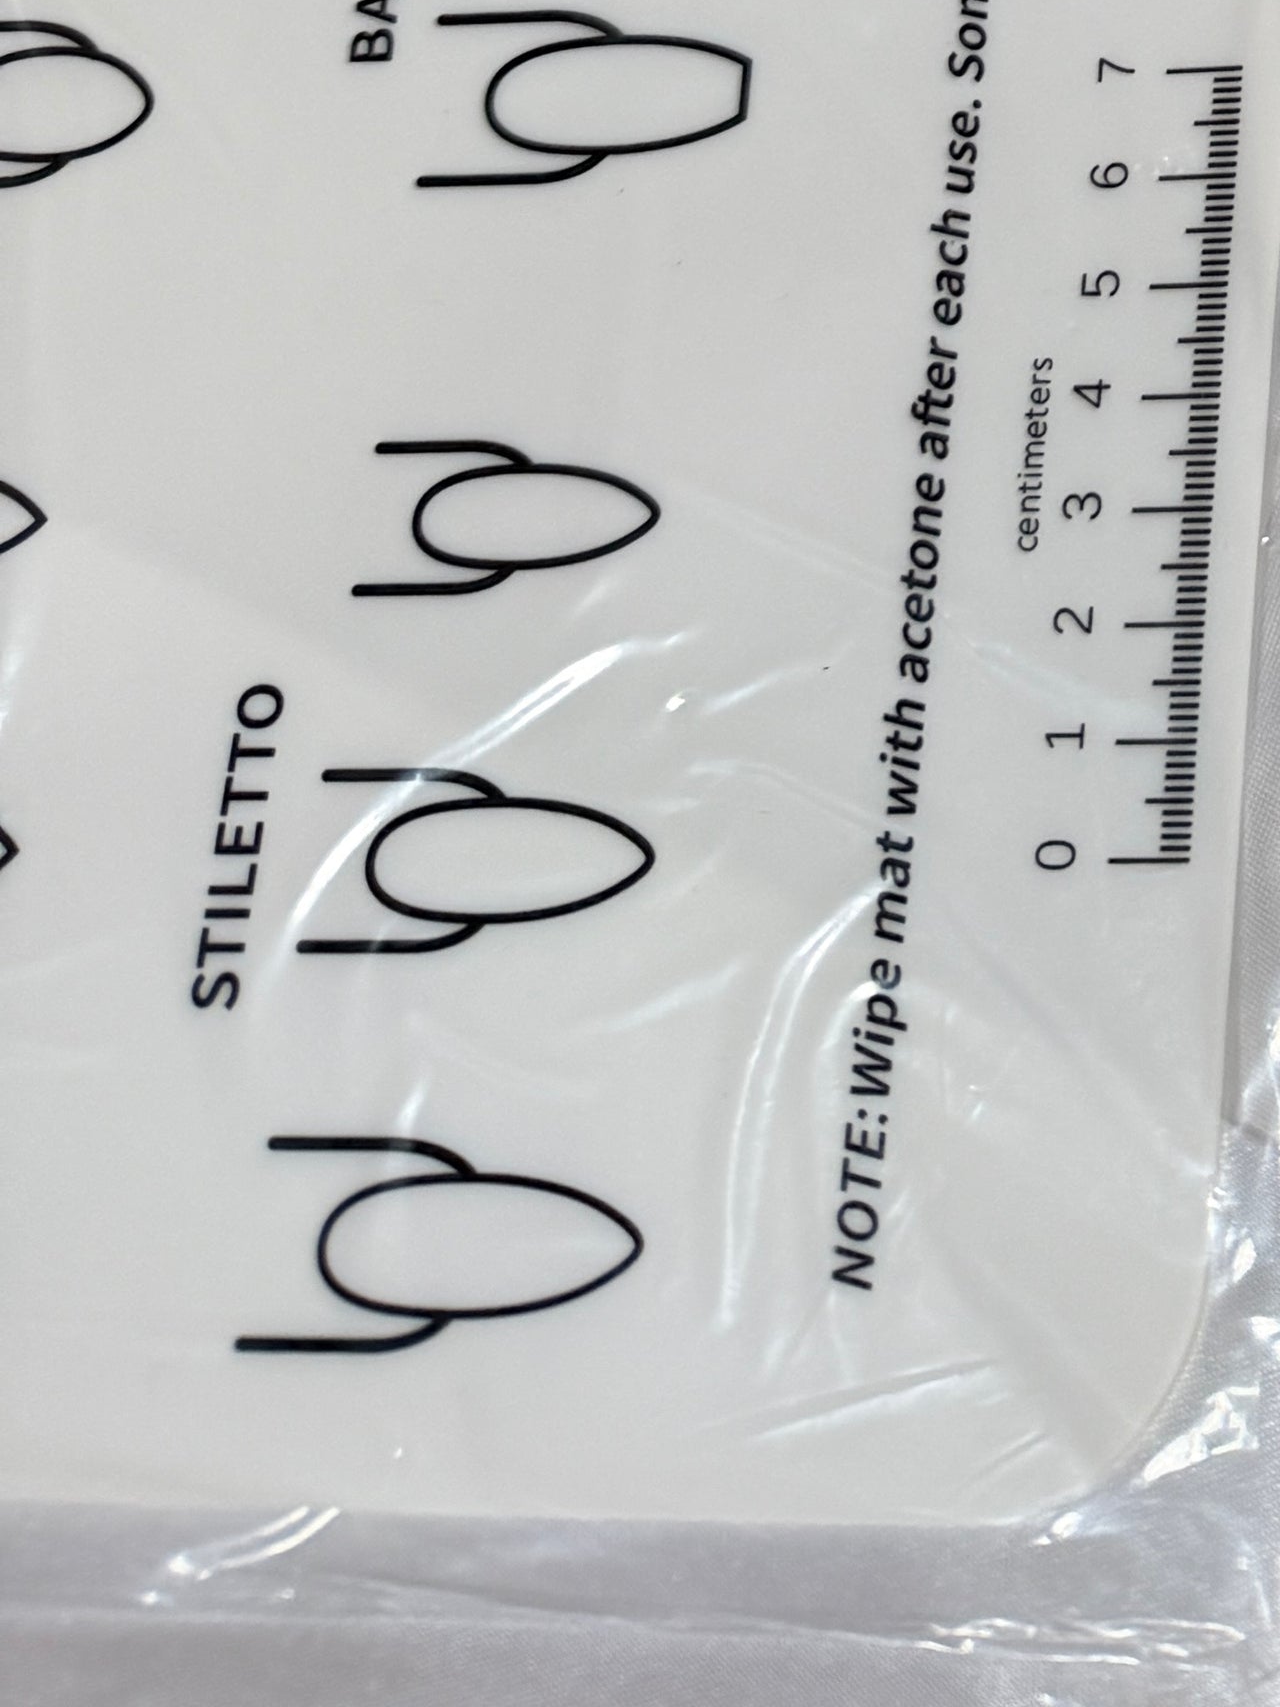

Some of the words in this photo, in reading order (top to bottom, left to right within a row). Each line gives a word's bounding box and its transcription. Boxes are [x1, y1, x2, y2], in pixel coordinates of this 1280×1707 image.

[1097, 57, 1136, 83] 7
[945, 99, 982, 195] use.
[1089, 162, 1129, 189] 6
[929, 208, 971, 327] each
[1080, 269, 1121, 297] 5
[910, 335, 958, 461] after
[1072, 378, 1112, 409] 4
[1017, 357, 1054, 553] centimeters
[1061, 491, 1102, 521] 3
[898, 472, 946, 684] acetone
[1052, 606, 1094, 635] 2
[879, 698, 926, 816] with
[1044, 722, 1086, 750] 1
[190, 683, 285, 1011] STILETTO
[874, 830, 914, 944] mat
[1034, 839, 1077, 871] 0
[849, 958, 908, 1097] Wipe
